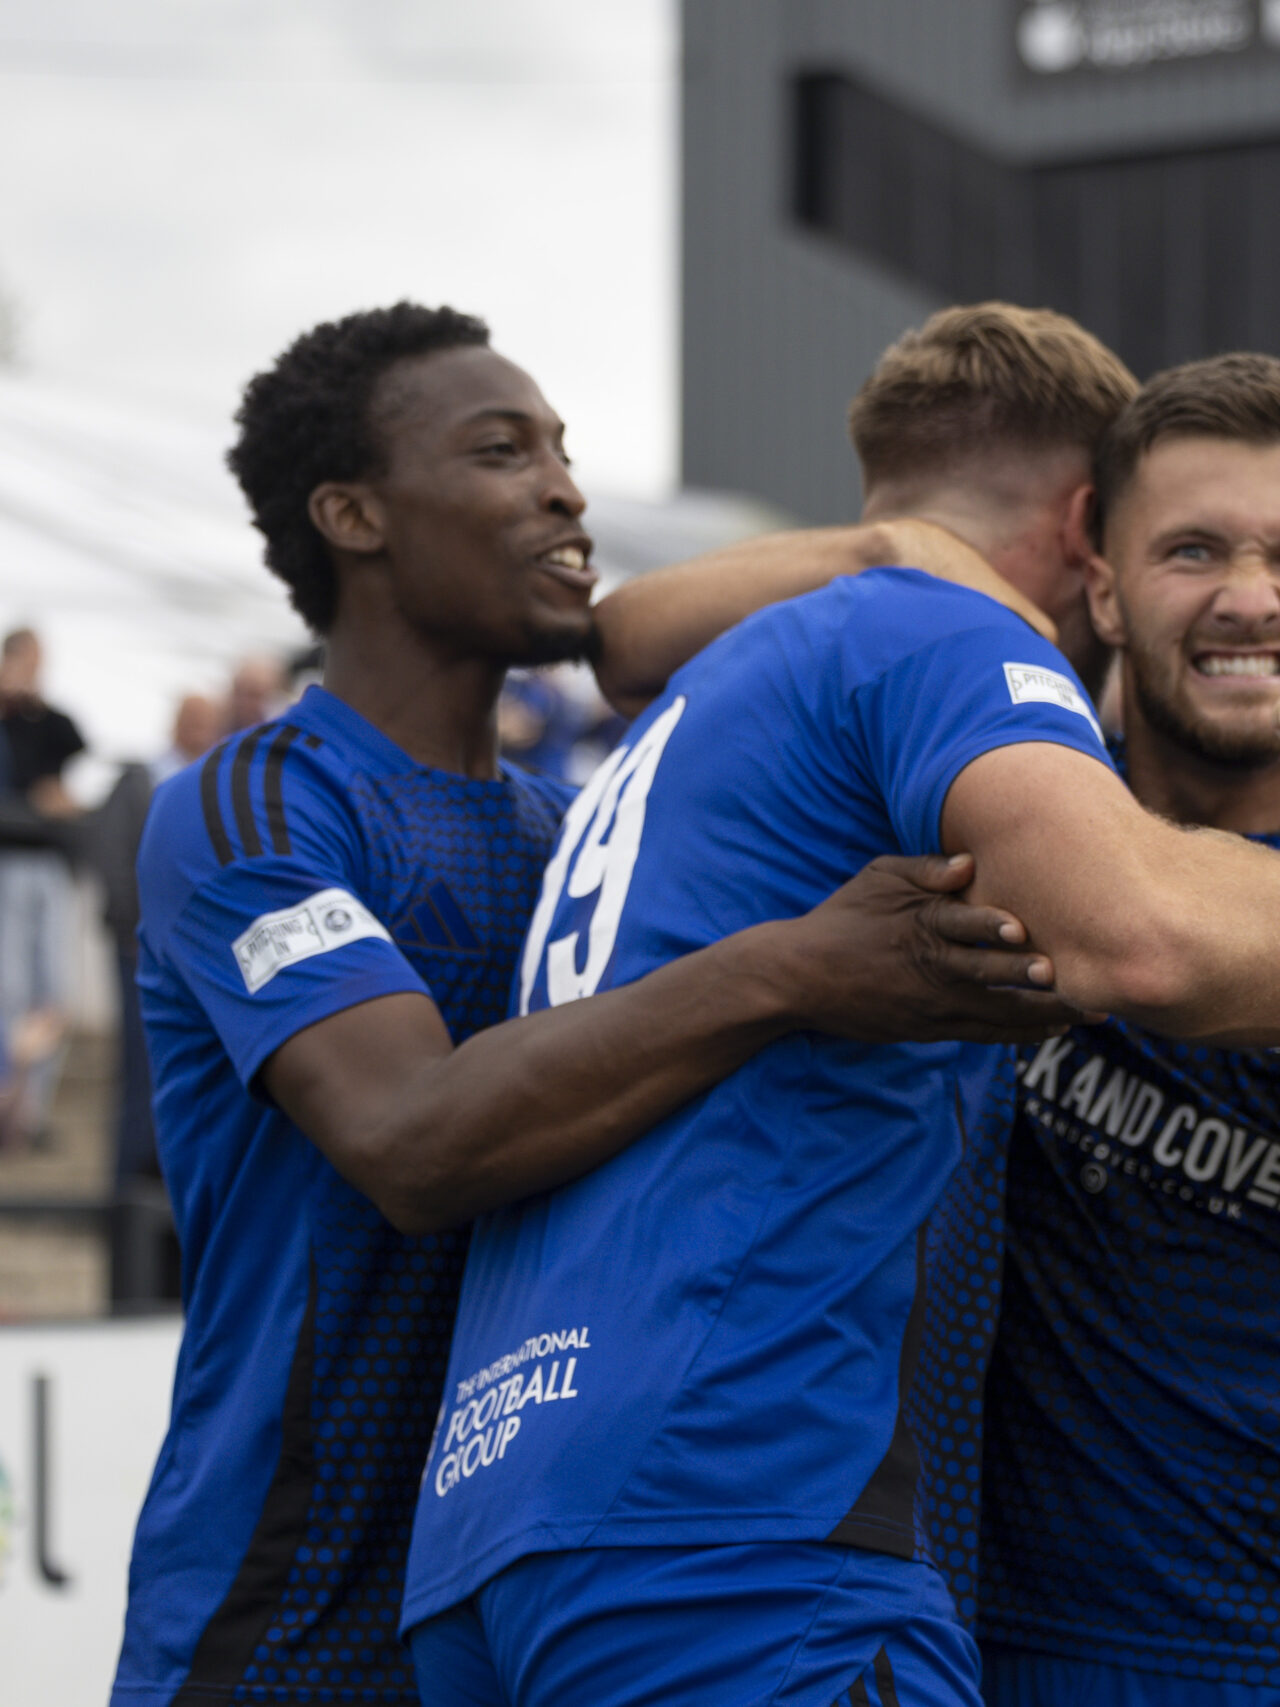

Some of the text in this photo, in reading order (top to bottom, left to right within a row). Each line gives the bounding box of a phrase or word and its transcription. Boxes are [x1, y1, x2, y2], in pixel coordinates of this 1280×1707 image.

[519, 695, 686, 1017] 19
[1016, 1035, 1075, 1101] K
[1060, 1055, 1164, 1148] AND
[443, 1356, 578, 1453] FOOTBALL
[456, 1326, 591, 1404] THE INTERNATIONAL
[435, 1414, 521, 1498] GROUP
